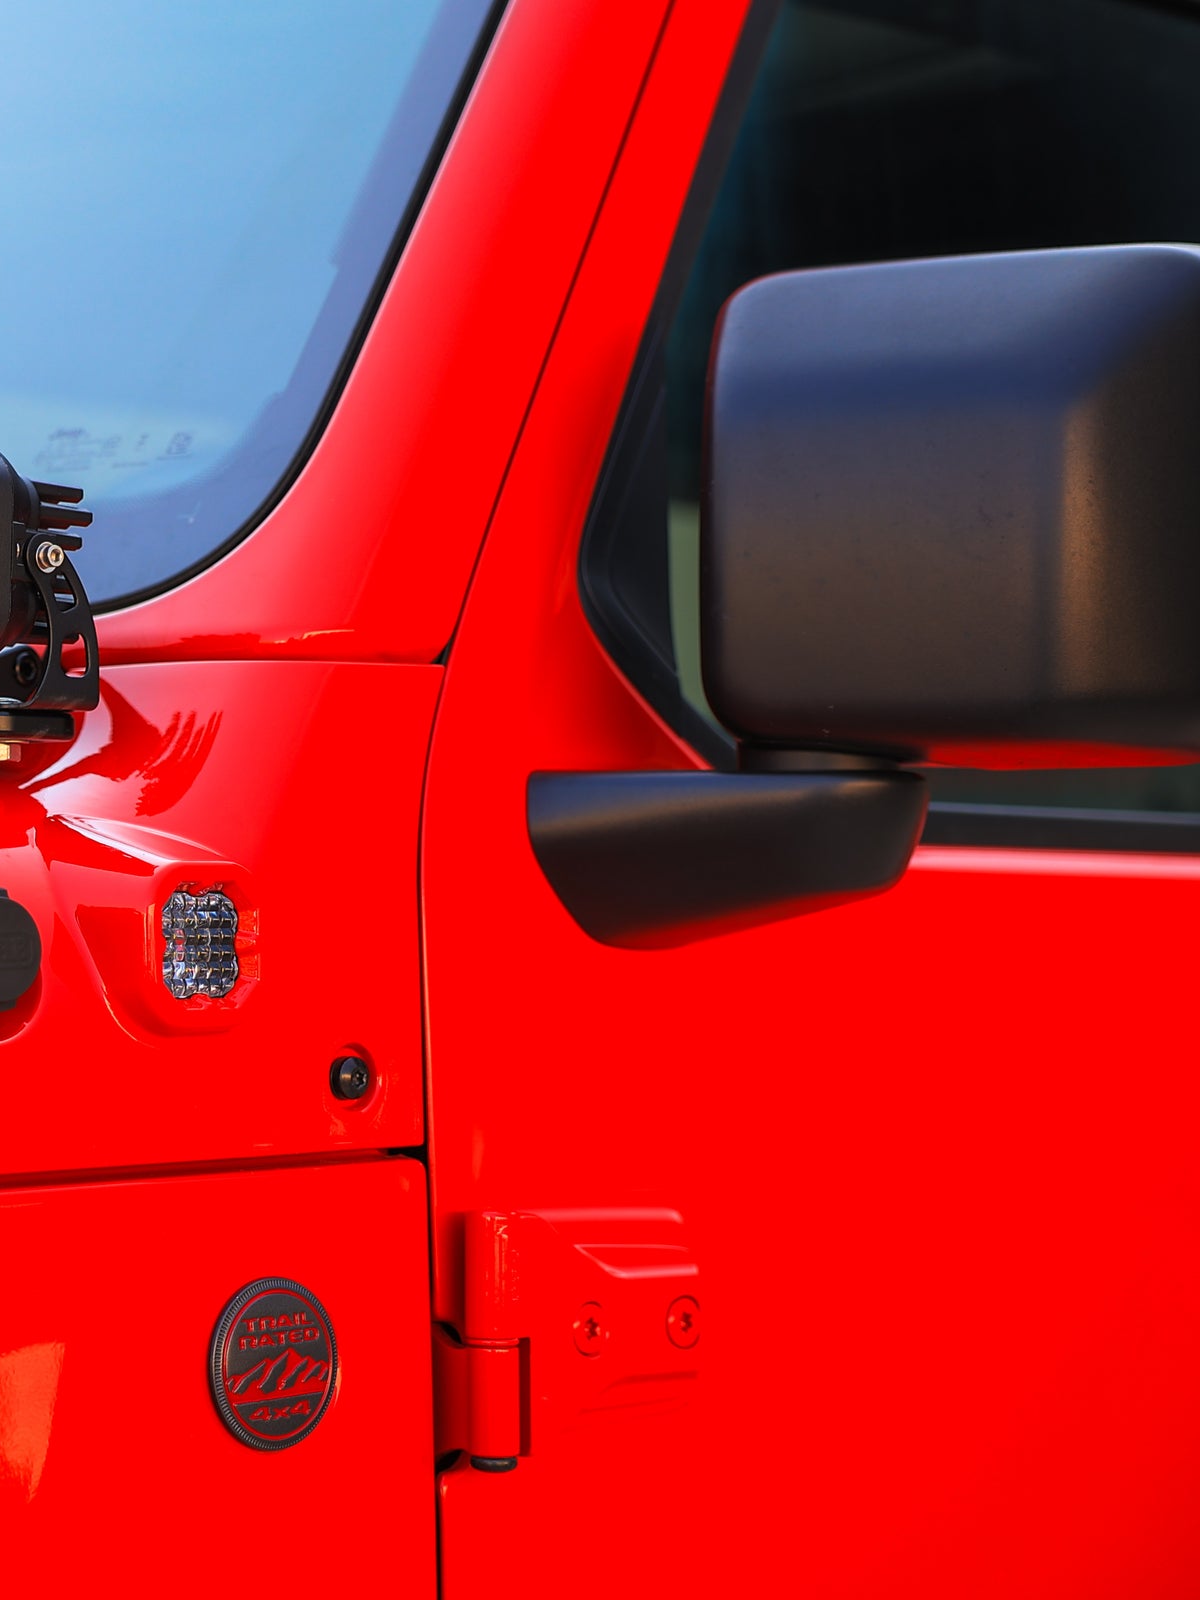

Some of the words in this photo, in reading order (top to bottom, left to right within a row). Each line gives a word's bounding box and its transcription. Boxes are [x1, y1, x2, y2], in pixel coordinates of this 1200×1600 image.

[241, 1312, 313, 1332] TRAIL
[239, 1327, 319, 1350] RATED
[250, 1401, 311, 1422] 4x4
